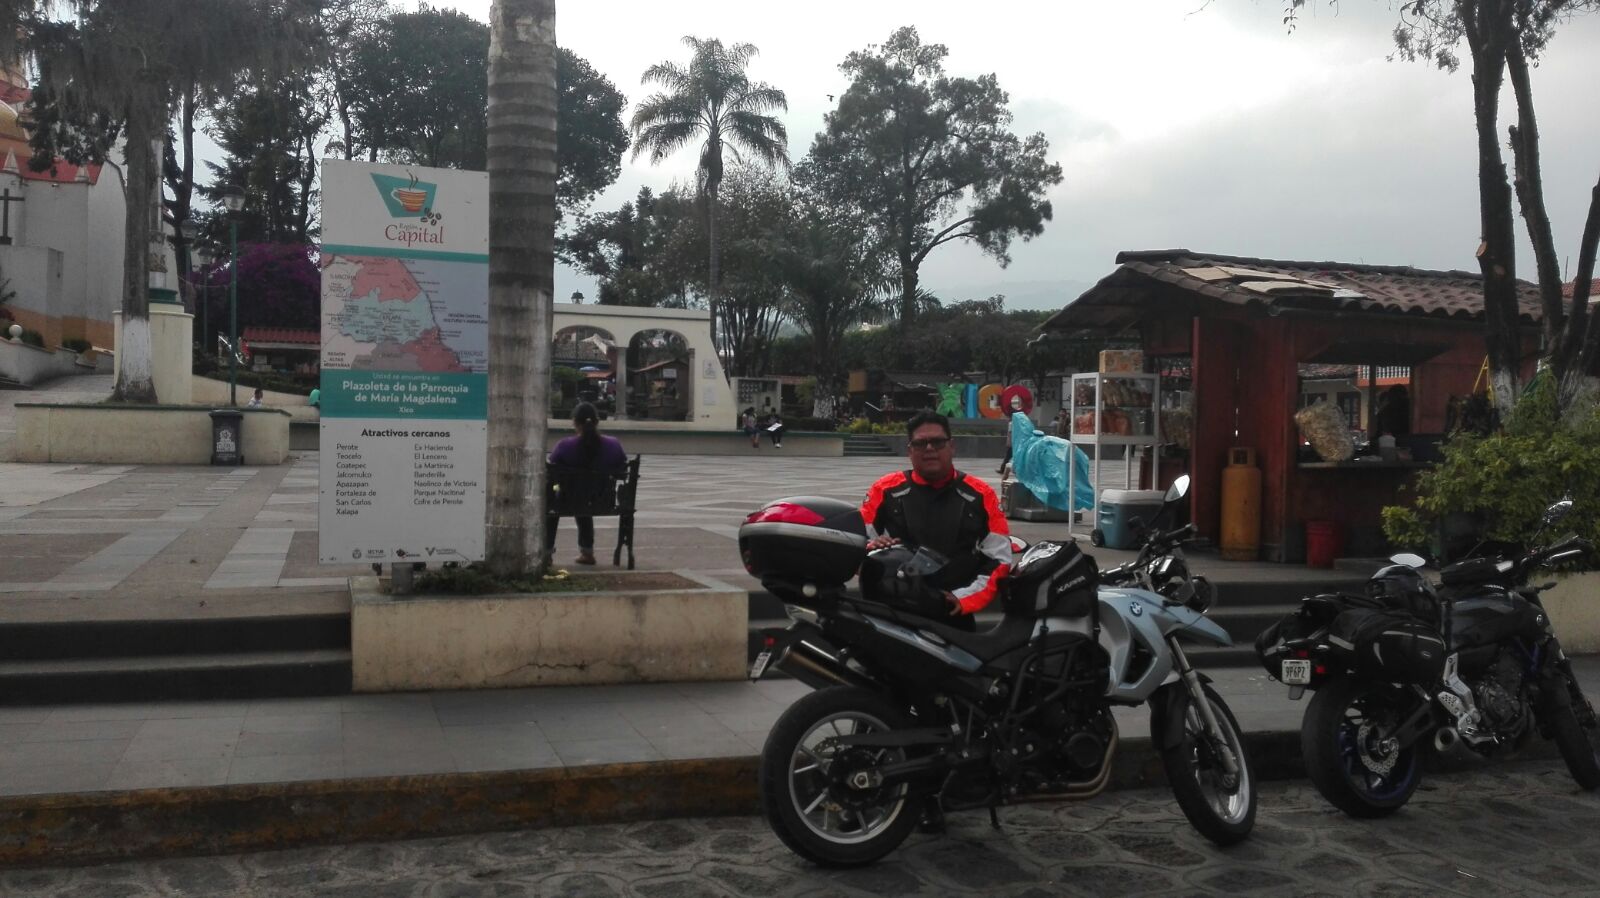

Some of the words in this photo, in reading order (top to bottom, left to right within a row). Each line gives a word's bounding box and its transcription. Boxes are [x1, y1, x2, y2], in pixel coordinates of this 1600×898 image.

[384, 224, 445, 247] Capital
[342, 380, 390, 391] Plazoleta
[393, 382, 405, 392] de
[408, 382, 417, 392] la
[420, 383, 469, 395] Parroquia
[354, 392, 367, 403] de
[402, 394, 457, 406] Magdalena
[936, 382, 1033, 418] XICO
[398, 406, 414, 414] Xico
[361, 428, 409, 437] Atractivos
[411, 430, 451, 438] cercanos
[336, 443, 359, 451] Perote
[336, 452, 362, 460] Teocelo
[336, 461, 367, 470] Coatepec
[335, 489, 367, 497] Fortaleza
[414, 489, 436, 497] Parque
[335, 508, 359, 516] Xalapa
